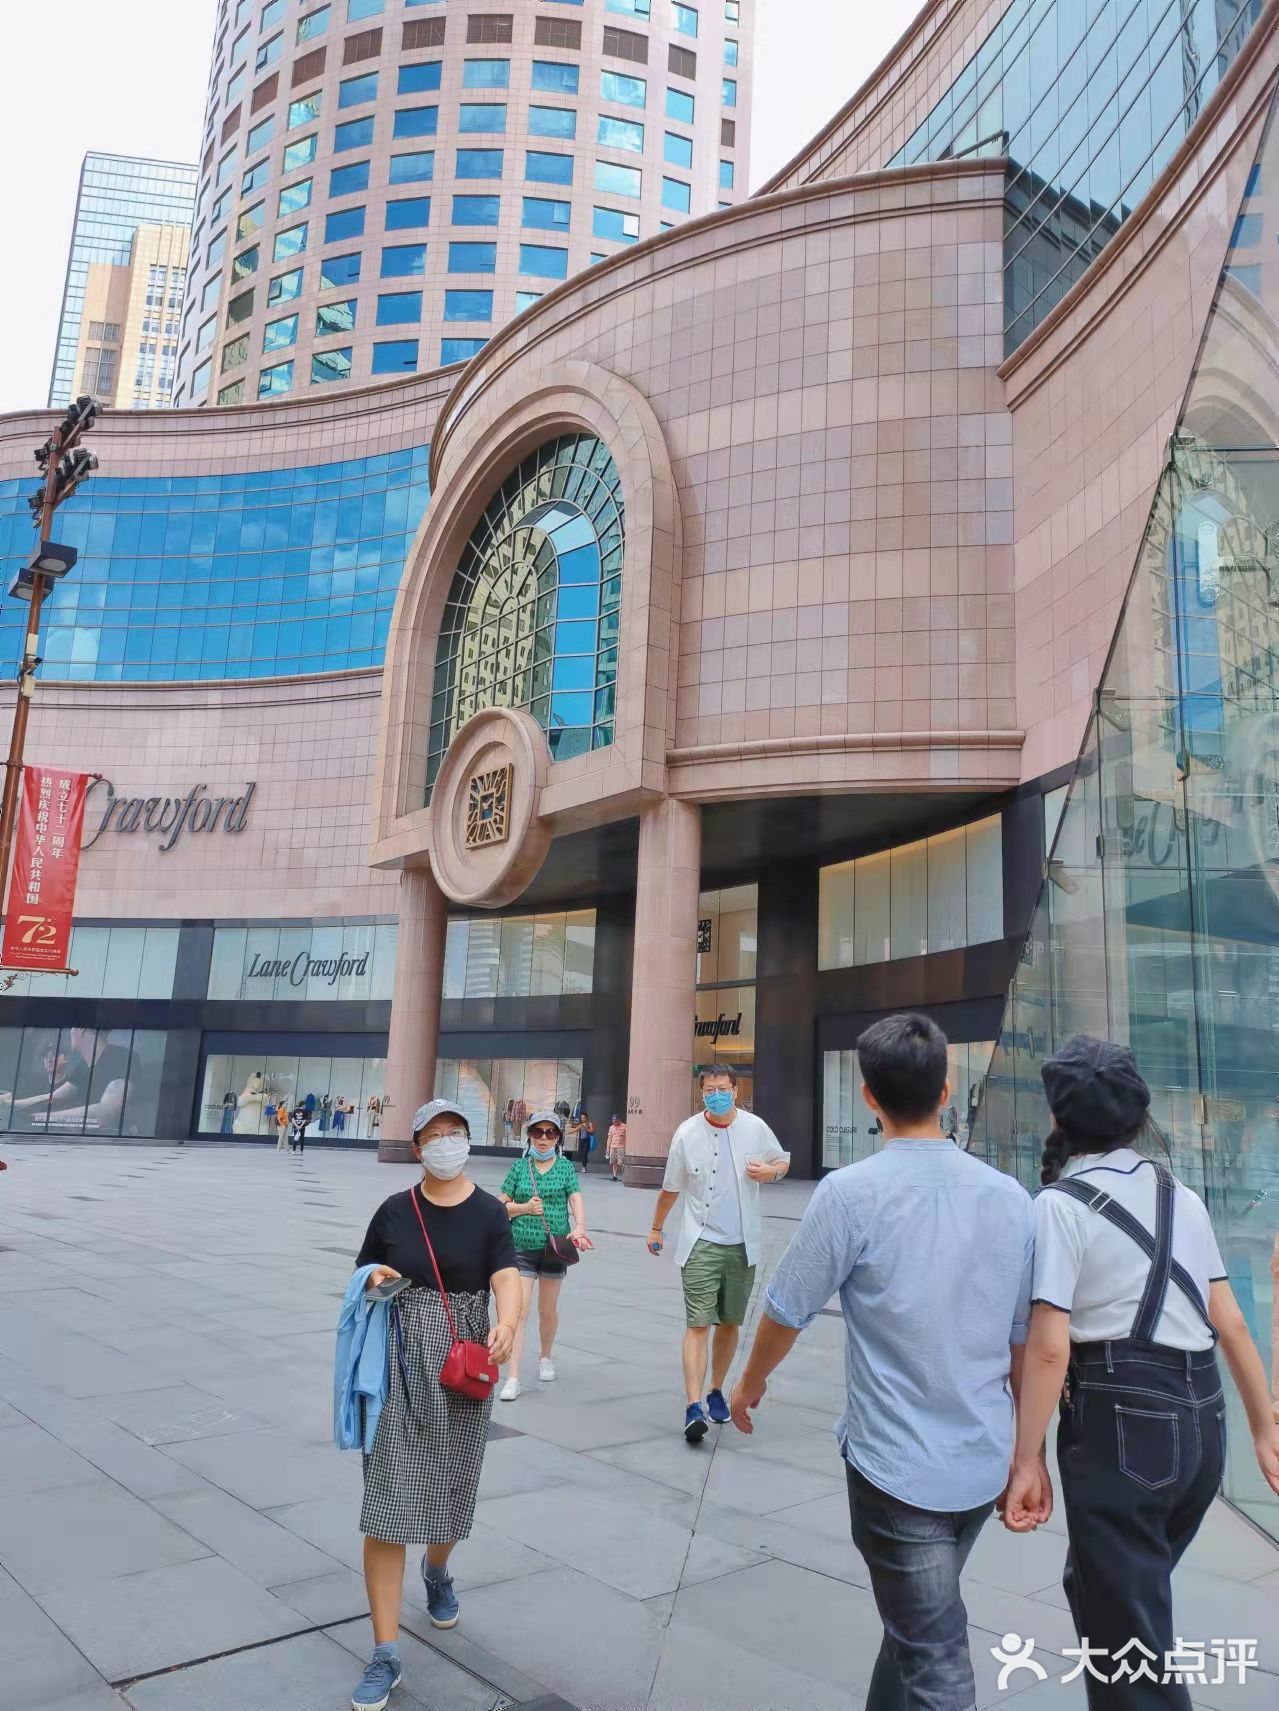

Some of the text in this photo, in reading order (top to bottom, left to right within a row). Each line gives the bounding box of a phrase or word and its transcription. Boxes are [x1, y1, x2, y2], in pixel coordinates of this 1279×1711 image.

[26, 776, 53, 904] 热烈庆祝中华人民共和国
[51, 779, 71, 859] 成立七十二周年
[16, 915, 57, 945] 72
[248, 951, 370, 987] Lane Crawford
